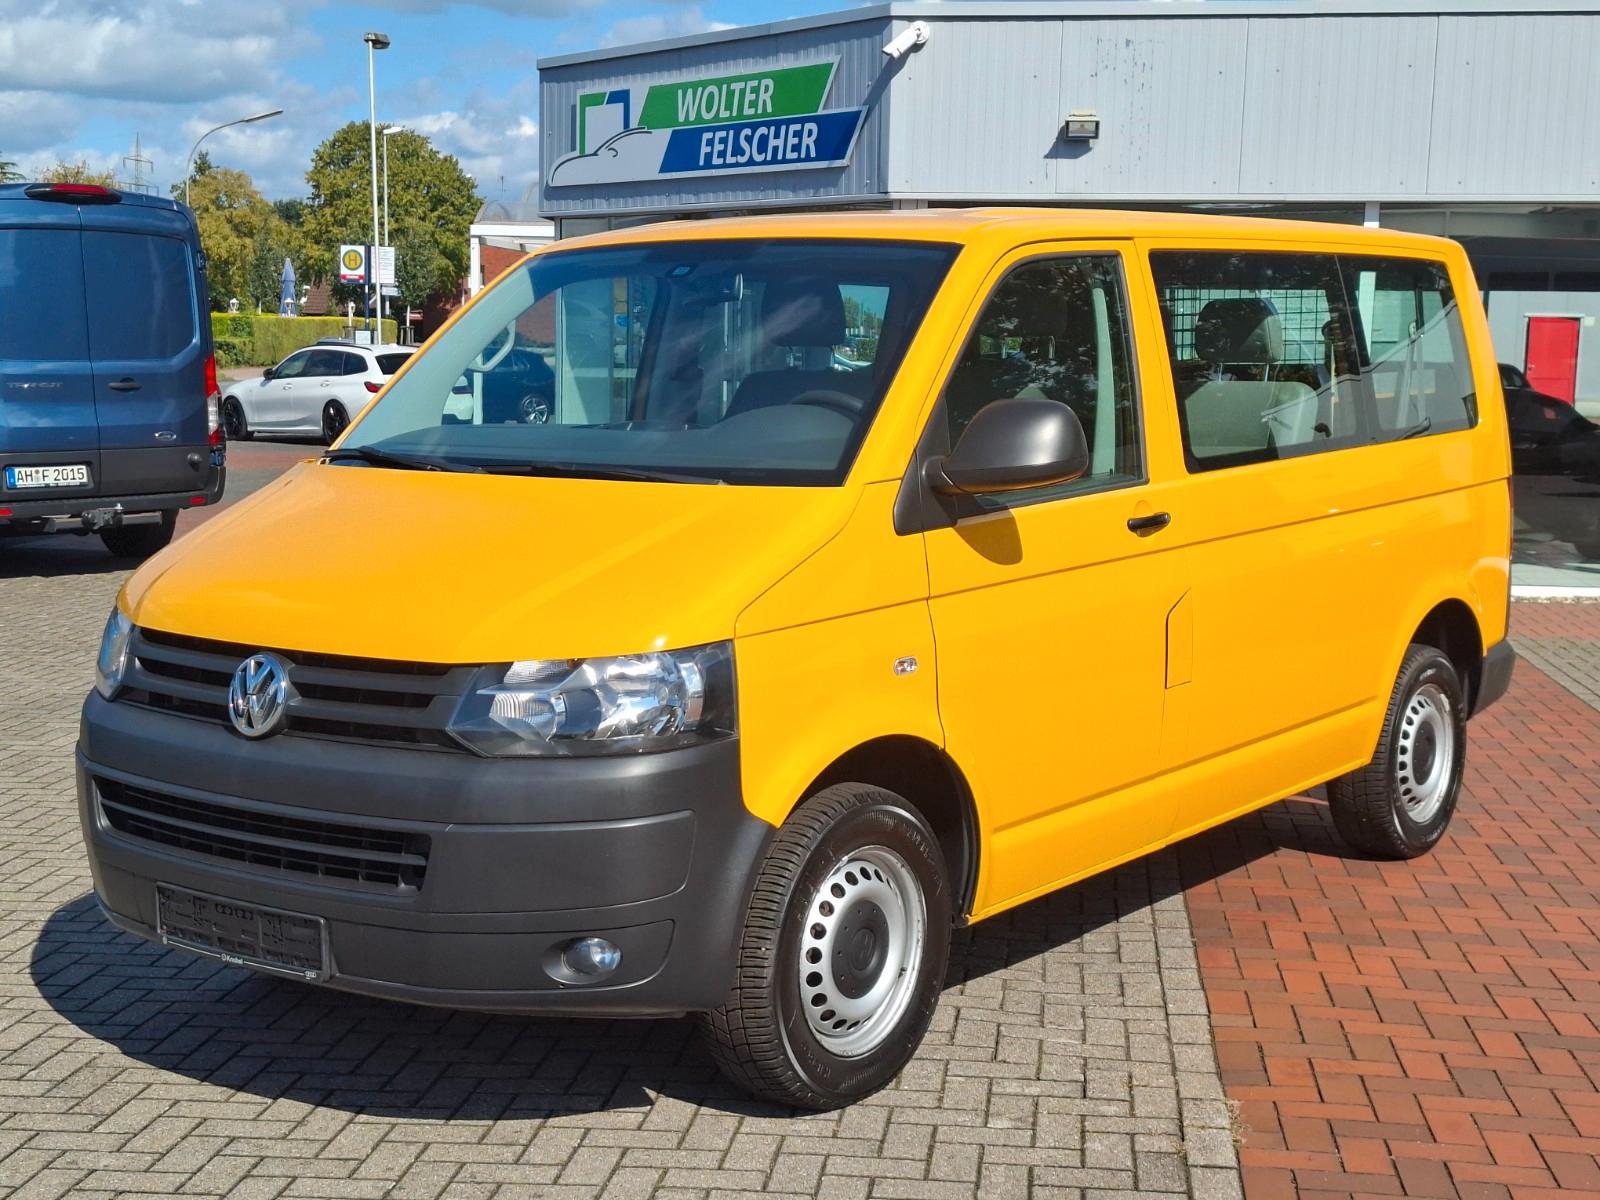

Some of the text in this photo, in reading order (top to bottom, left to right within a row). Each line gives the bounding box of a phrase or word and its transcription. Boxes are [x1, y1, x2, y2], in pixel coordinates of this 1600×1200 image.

[677, 78, 774, 122] WOLTER
[699, 122, 818, 166] FELSCHER
[17, 467, 85, 483] AH F 2015
